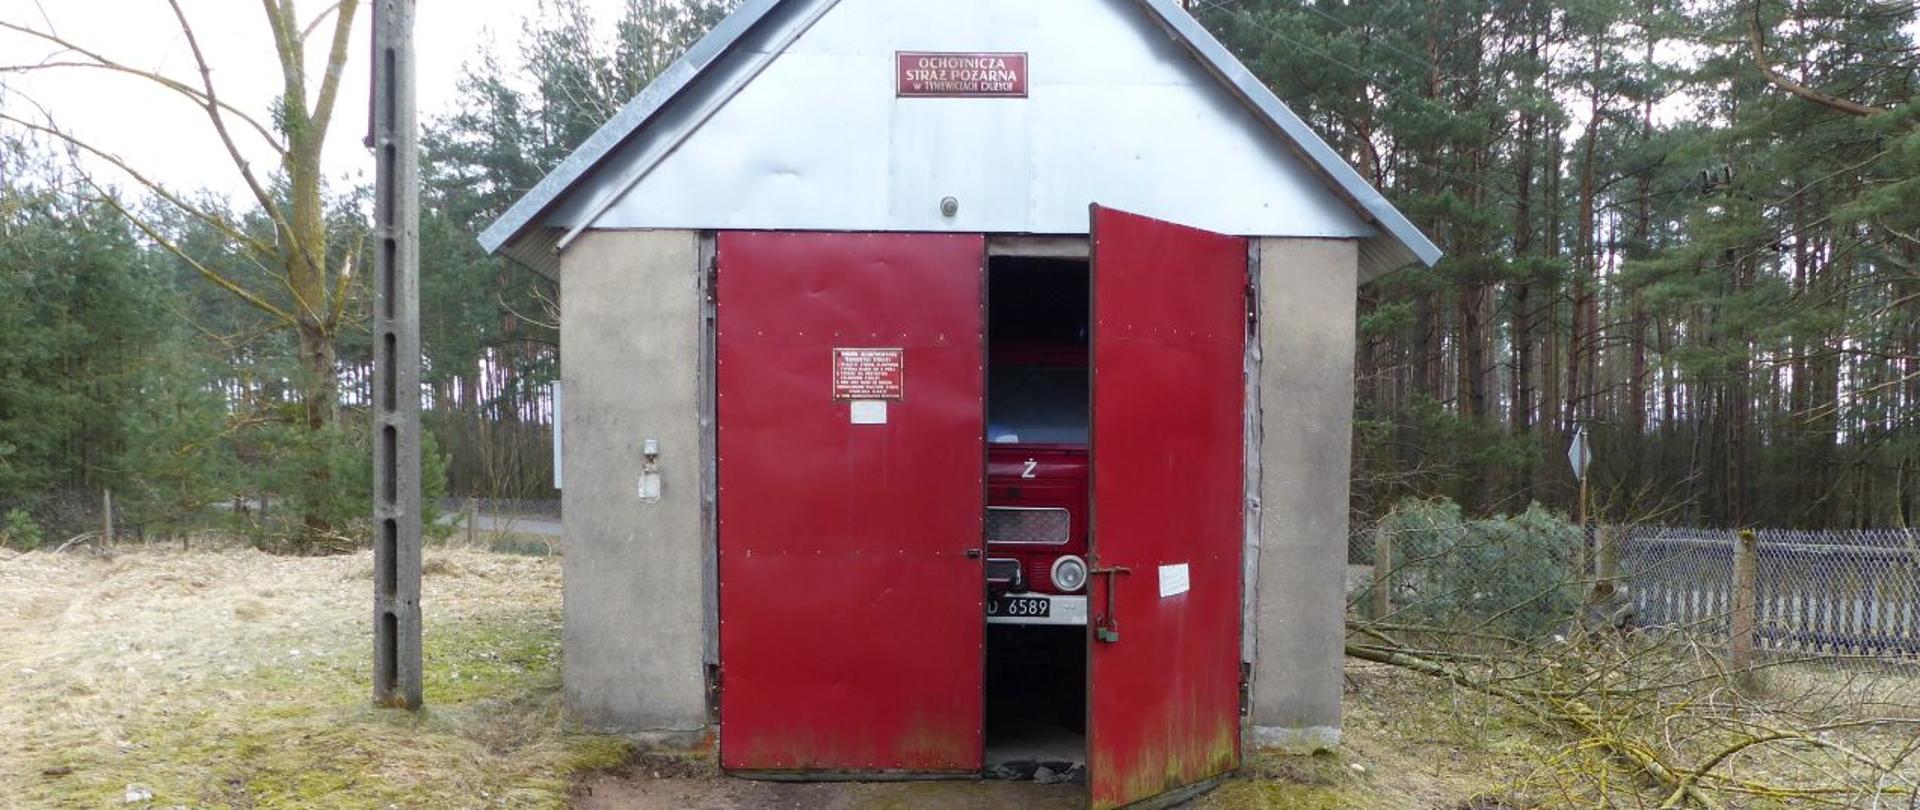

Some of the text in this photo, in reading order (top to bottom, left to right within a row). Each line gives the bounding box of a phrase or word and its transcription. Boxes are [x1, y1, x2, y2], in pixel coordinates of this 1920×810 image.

[918, 57, 1006, 69] OCHOTNICZA
[951, 69, 1017, 81] POŻARNA
[1021, 458, 1038, 479] Ż
[1009, 599, 1047, 614] 6589
